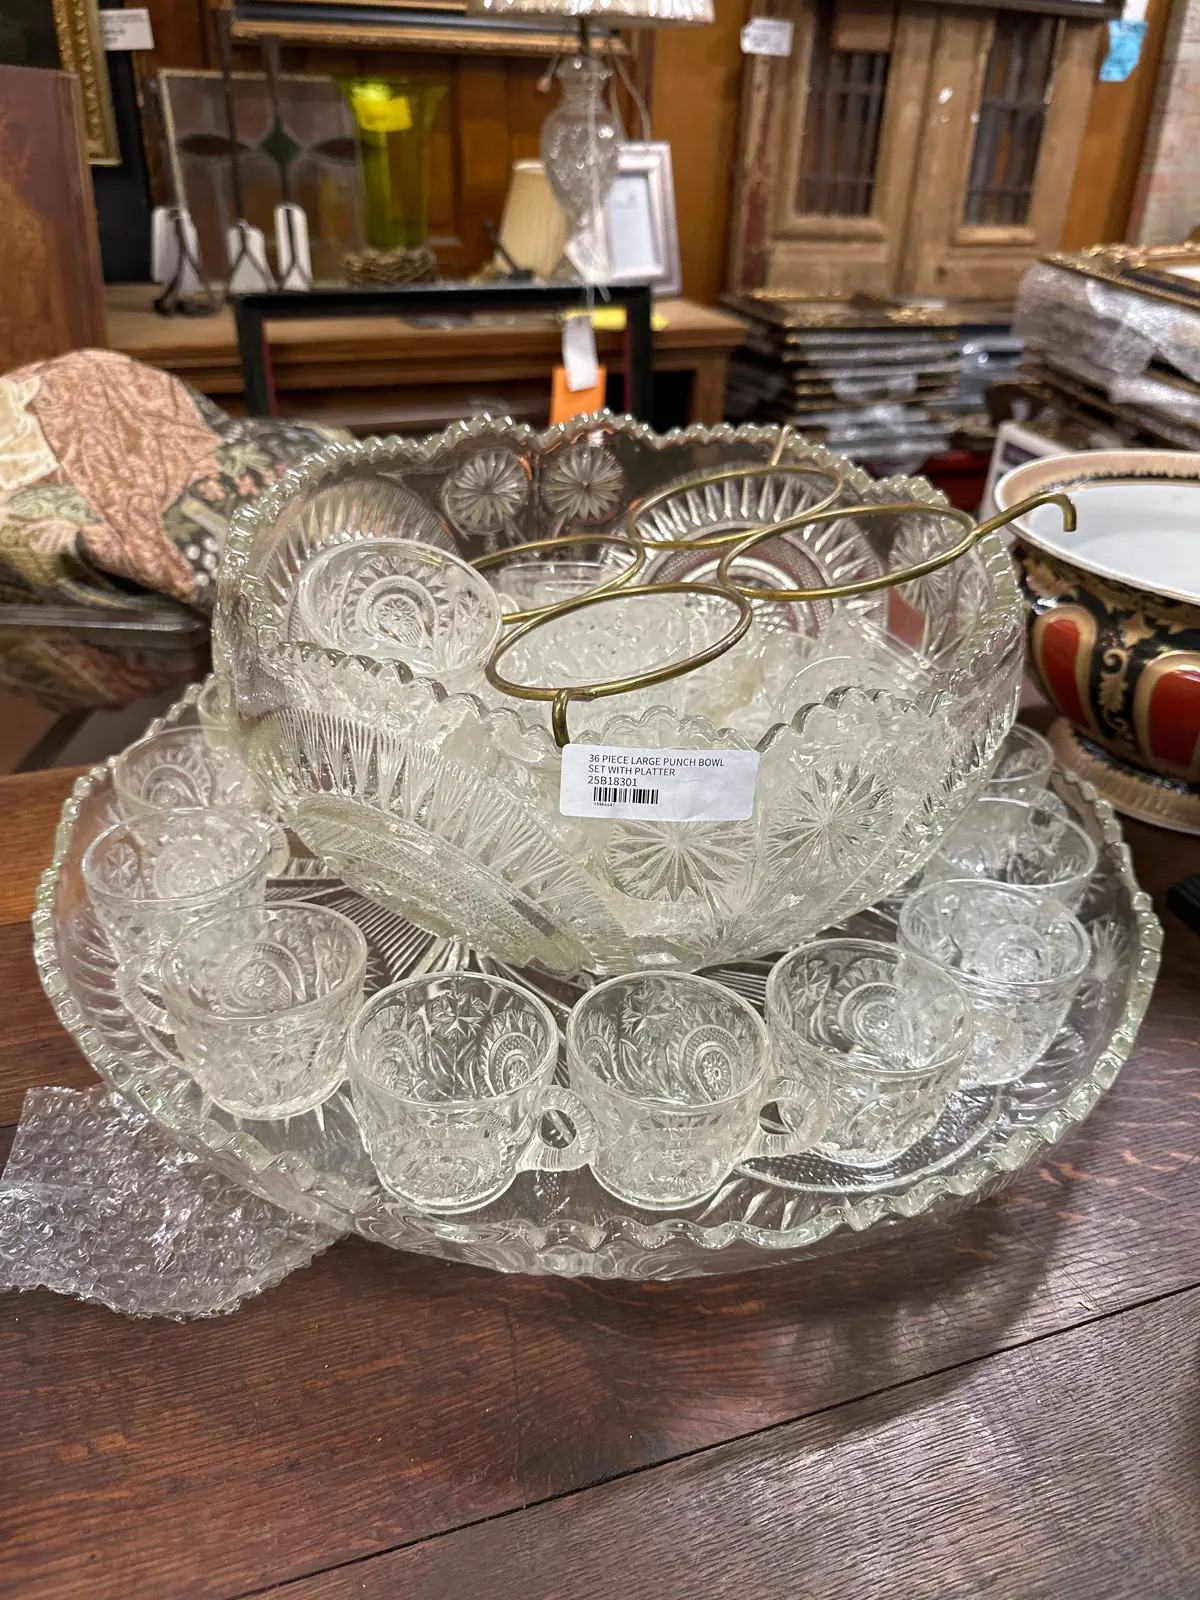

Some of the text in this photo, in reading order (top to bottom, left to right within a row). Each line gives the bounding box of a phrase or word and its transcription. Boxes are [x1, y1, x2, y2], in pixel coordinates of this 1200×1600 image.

[588, 754, 725, 767] 36 PIECE LARGE PUNCH BOWL
[588, 765, 676, 776] SET WITH PLATTER
[587, 775, 638, 787] 25B18301
